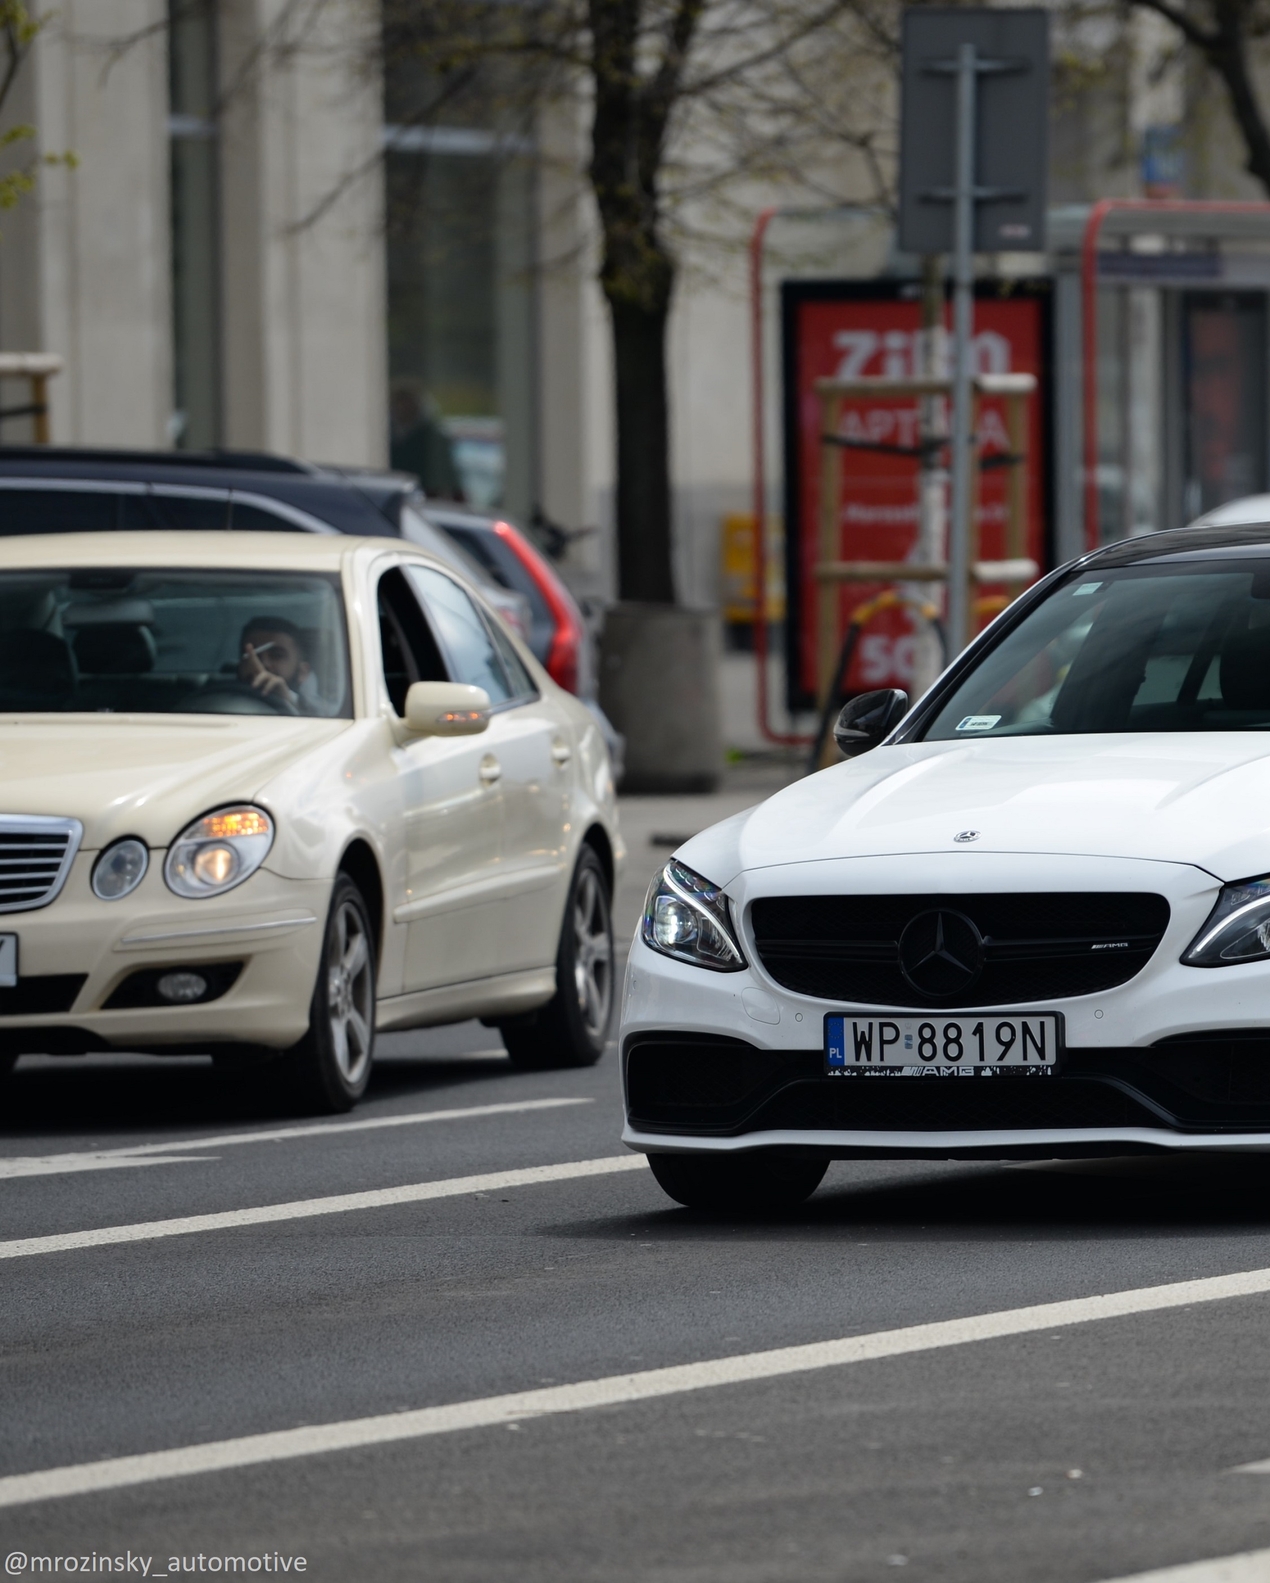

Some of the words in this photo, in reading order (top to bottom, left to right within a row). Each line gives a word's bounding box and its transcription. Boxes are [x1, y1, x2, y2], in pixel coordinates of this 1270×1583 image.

[852, 1021, 900, 1062] WP
[917, 1021, 1047, 1062] 8819N
[829, 1048, 842, 1059] PL
[921, 1066, 975, 1077] AMG
